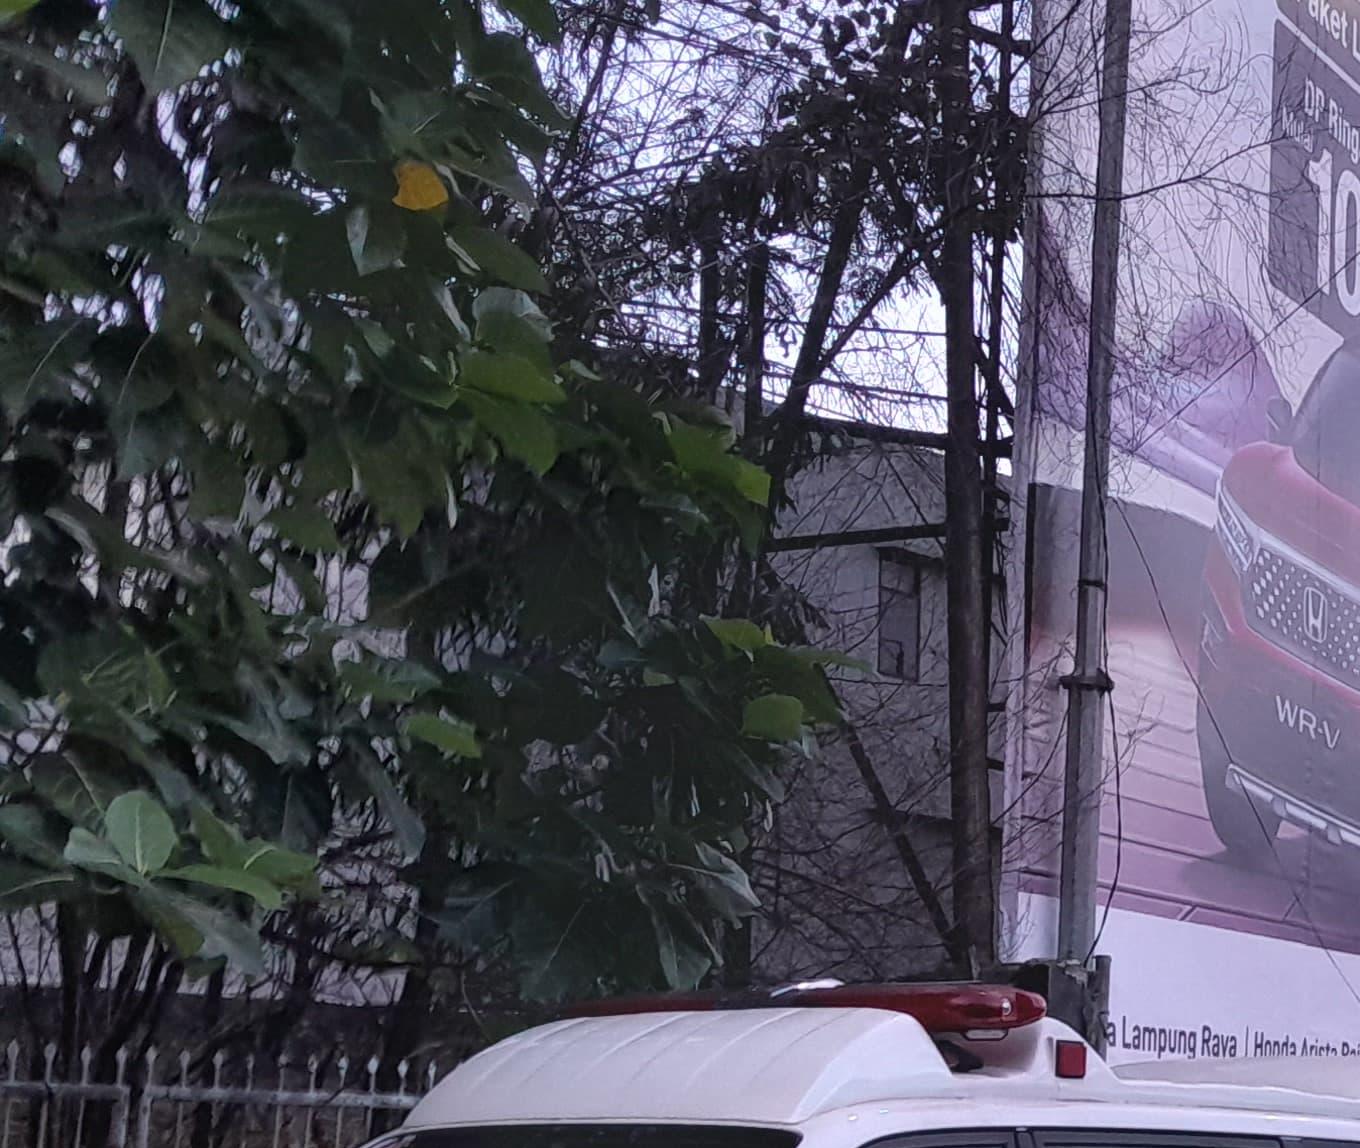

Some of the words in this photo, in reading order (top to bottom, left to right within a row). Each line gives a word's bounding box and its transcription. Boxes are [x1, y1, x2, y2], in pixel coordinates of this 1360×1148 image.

[1303, 0, 1349, 49] aket
[1275, 694, 1341, 751] WR-V
[1121, 1014, 1199, 1059] Lampung
[1253, 1031, 1298, 1058] Honda
